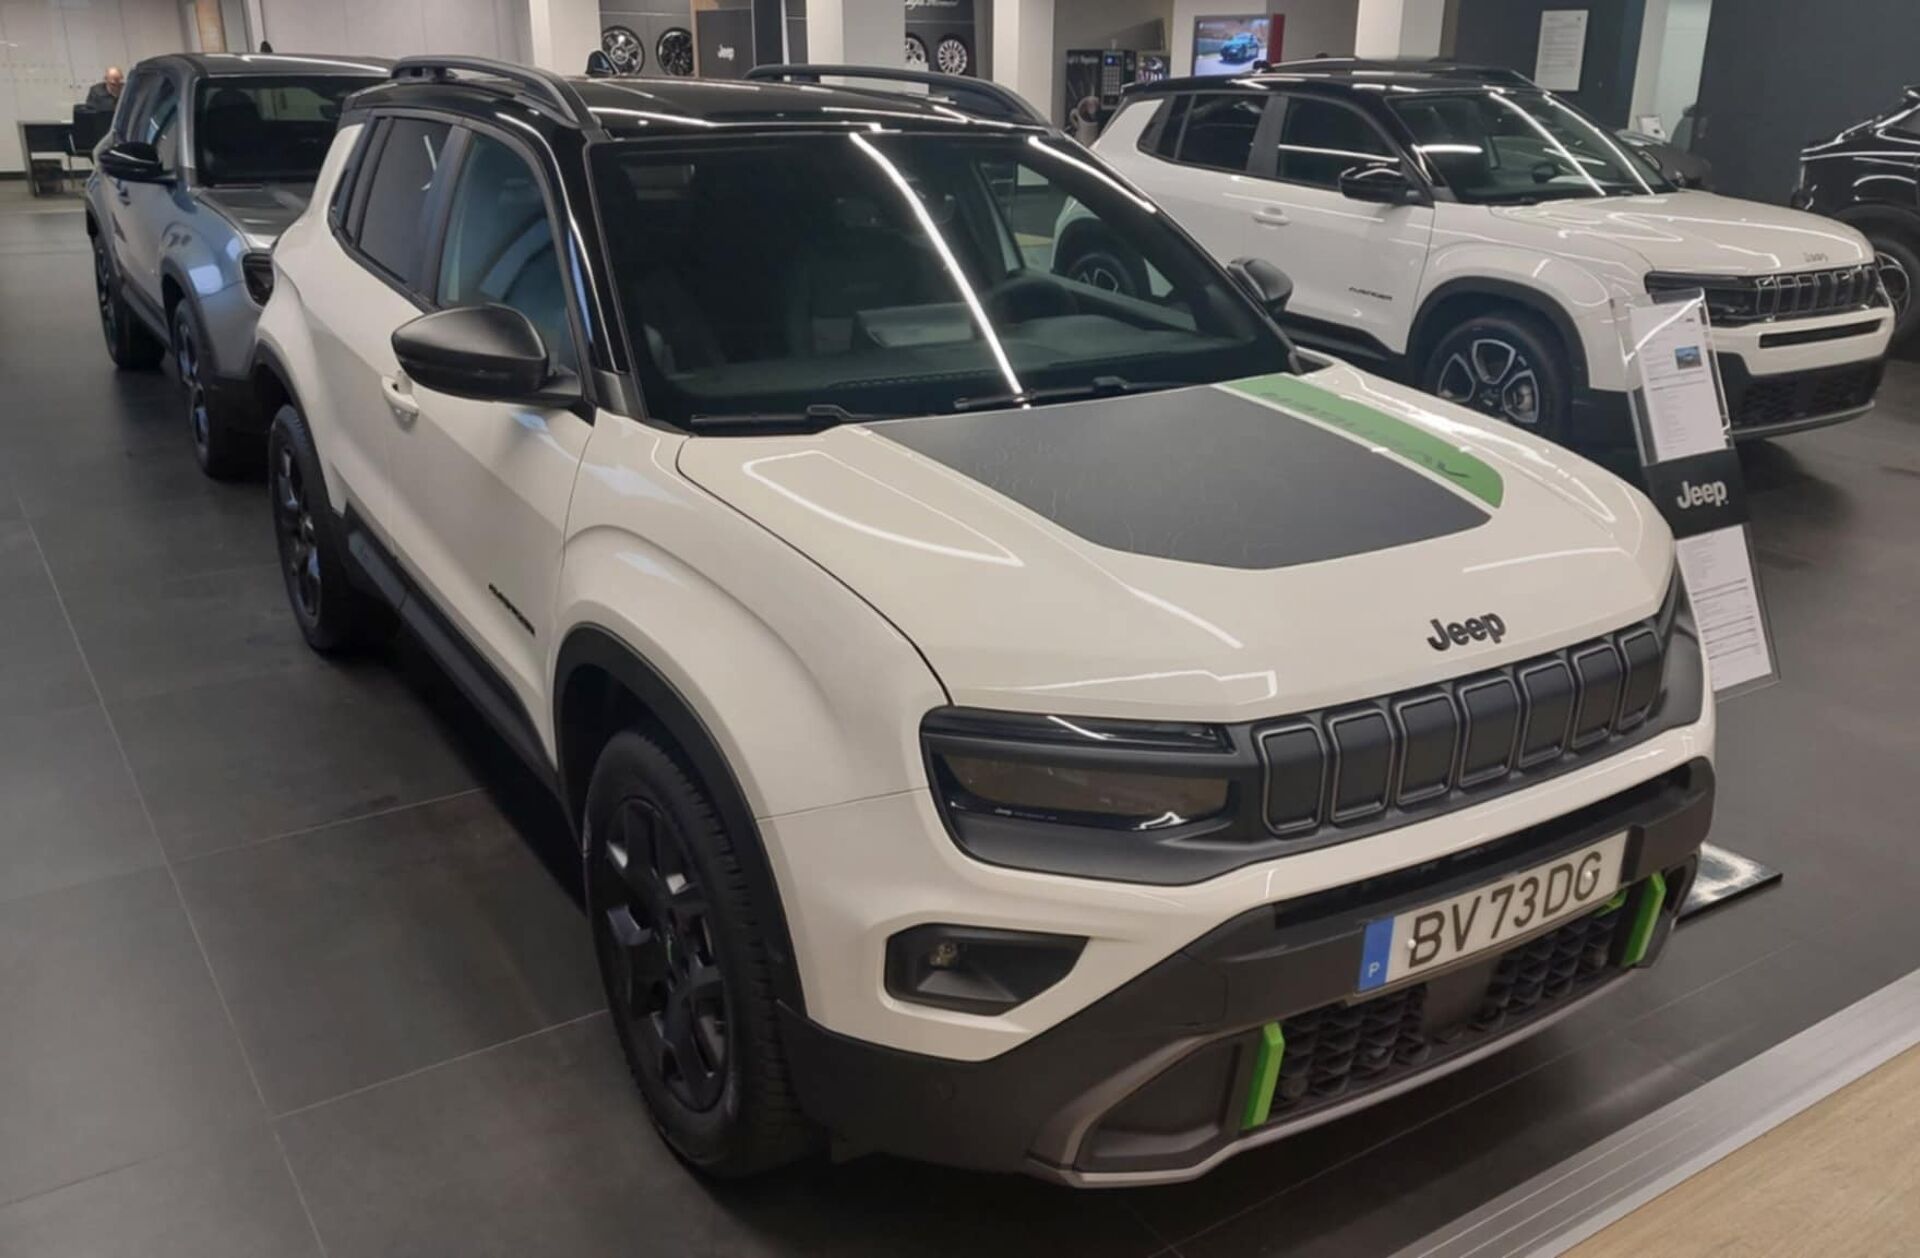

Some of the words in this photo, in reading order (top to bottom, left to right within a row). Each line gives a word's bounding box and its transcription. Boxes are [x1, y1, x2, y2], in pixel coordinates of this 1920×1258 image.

[1677, 480, 1728, 509] Jeep
[1427, 613, 1506, 652] Jeep
[1368, 960, 1381, 979] P
